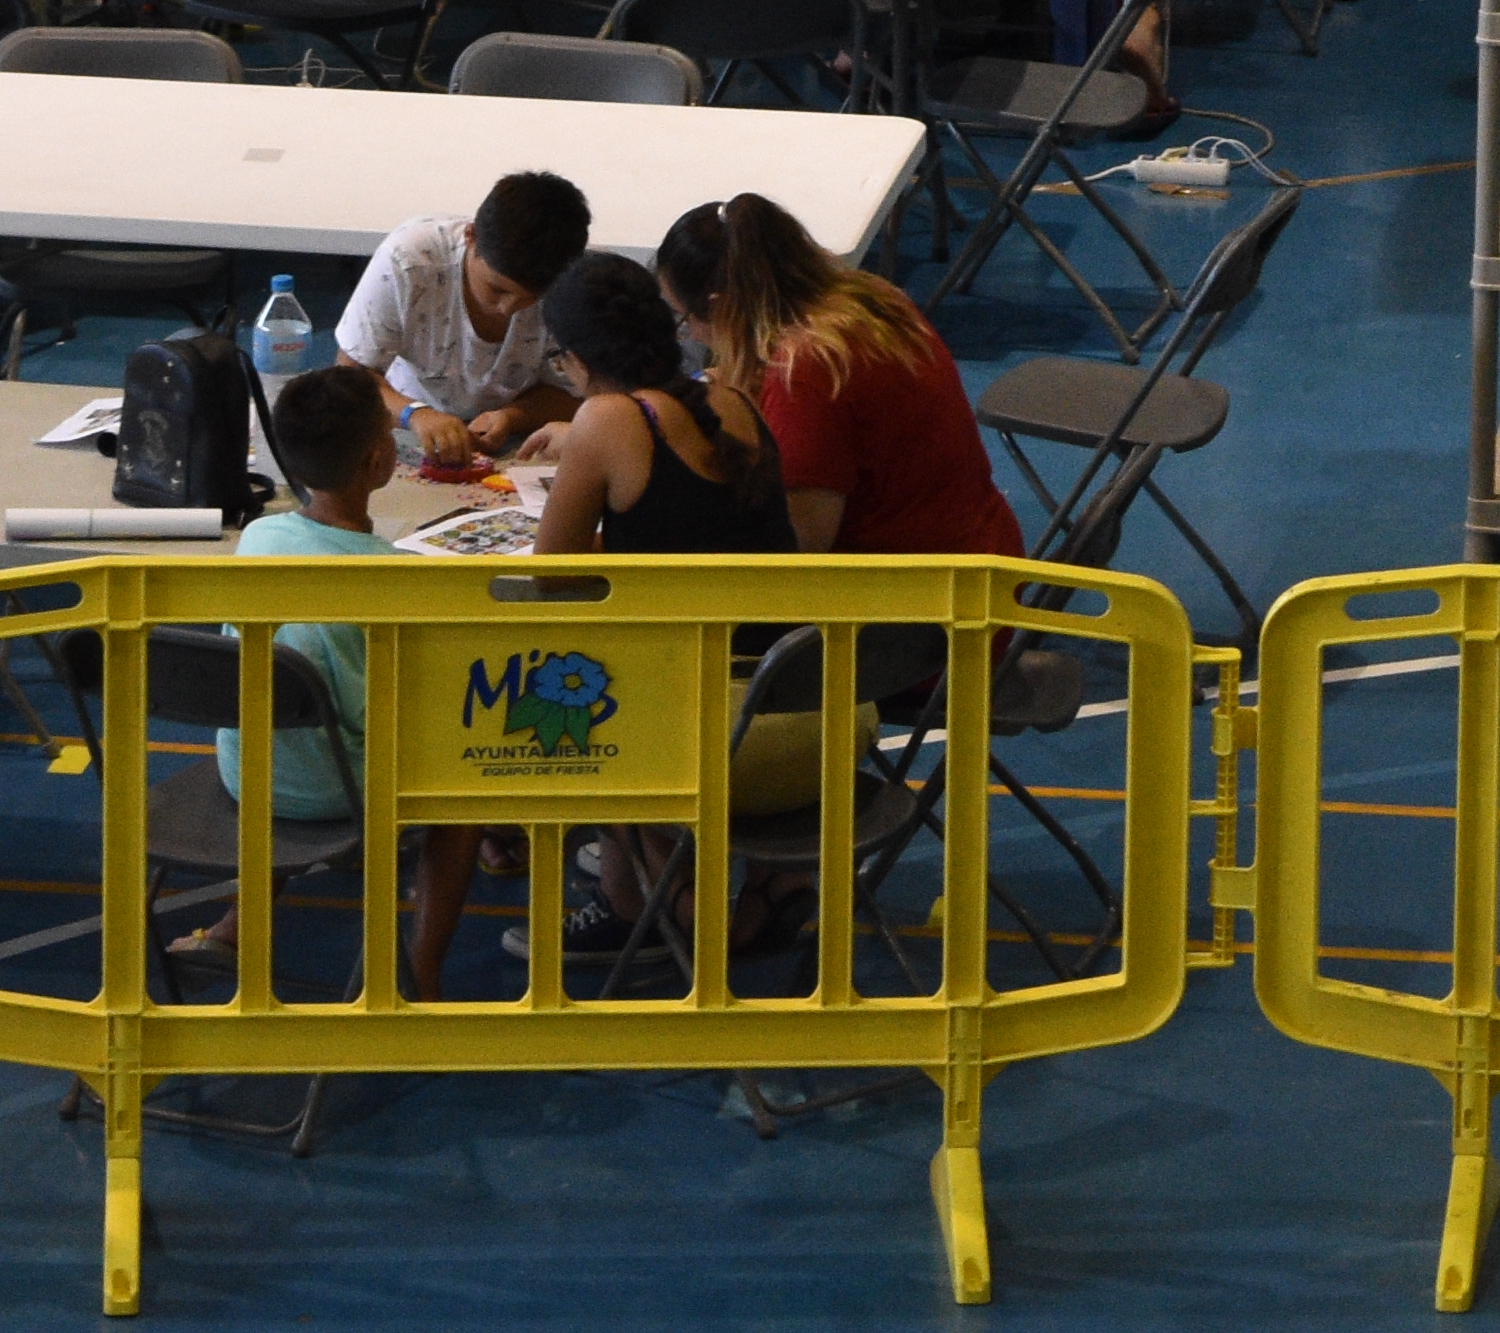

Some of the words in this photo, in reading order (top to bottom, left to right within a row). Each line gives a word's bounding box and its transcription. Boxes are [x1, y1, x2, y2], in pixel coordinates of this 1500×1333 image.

[481, 764, 532, 777] EQUIPO
[534, 765, 552, 775] DE
[556, 764, 600, 775] FIESTA
